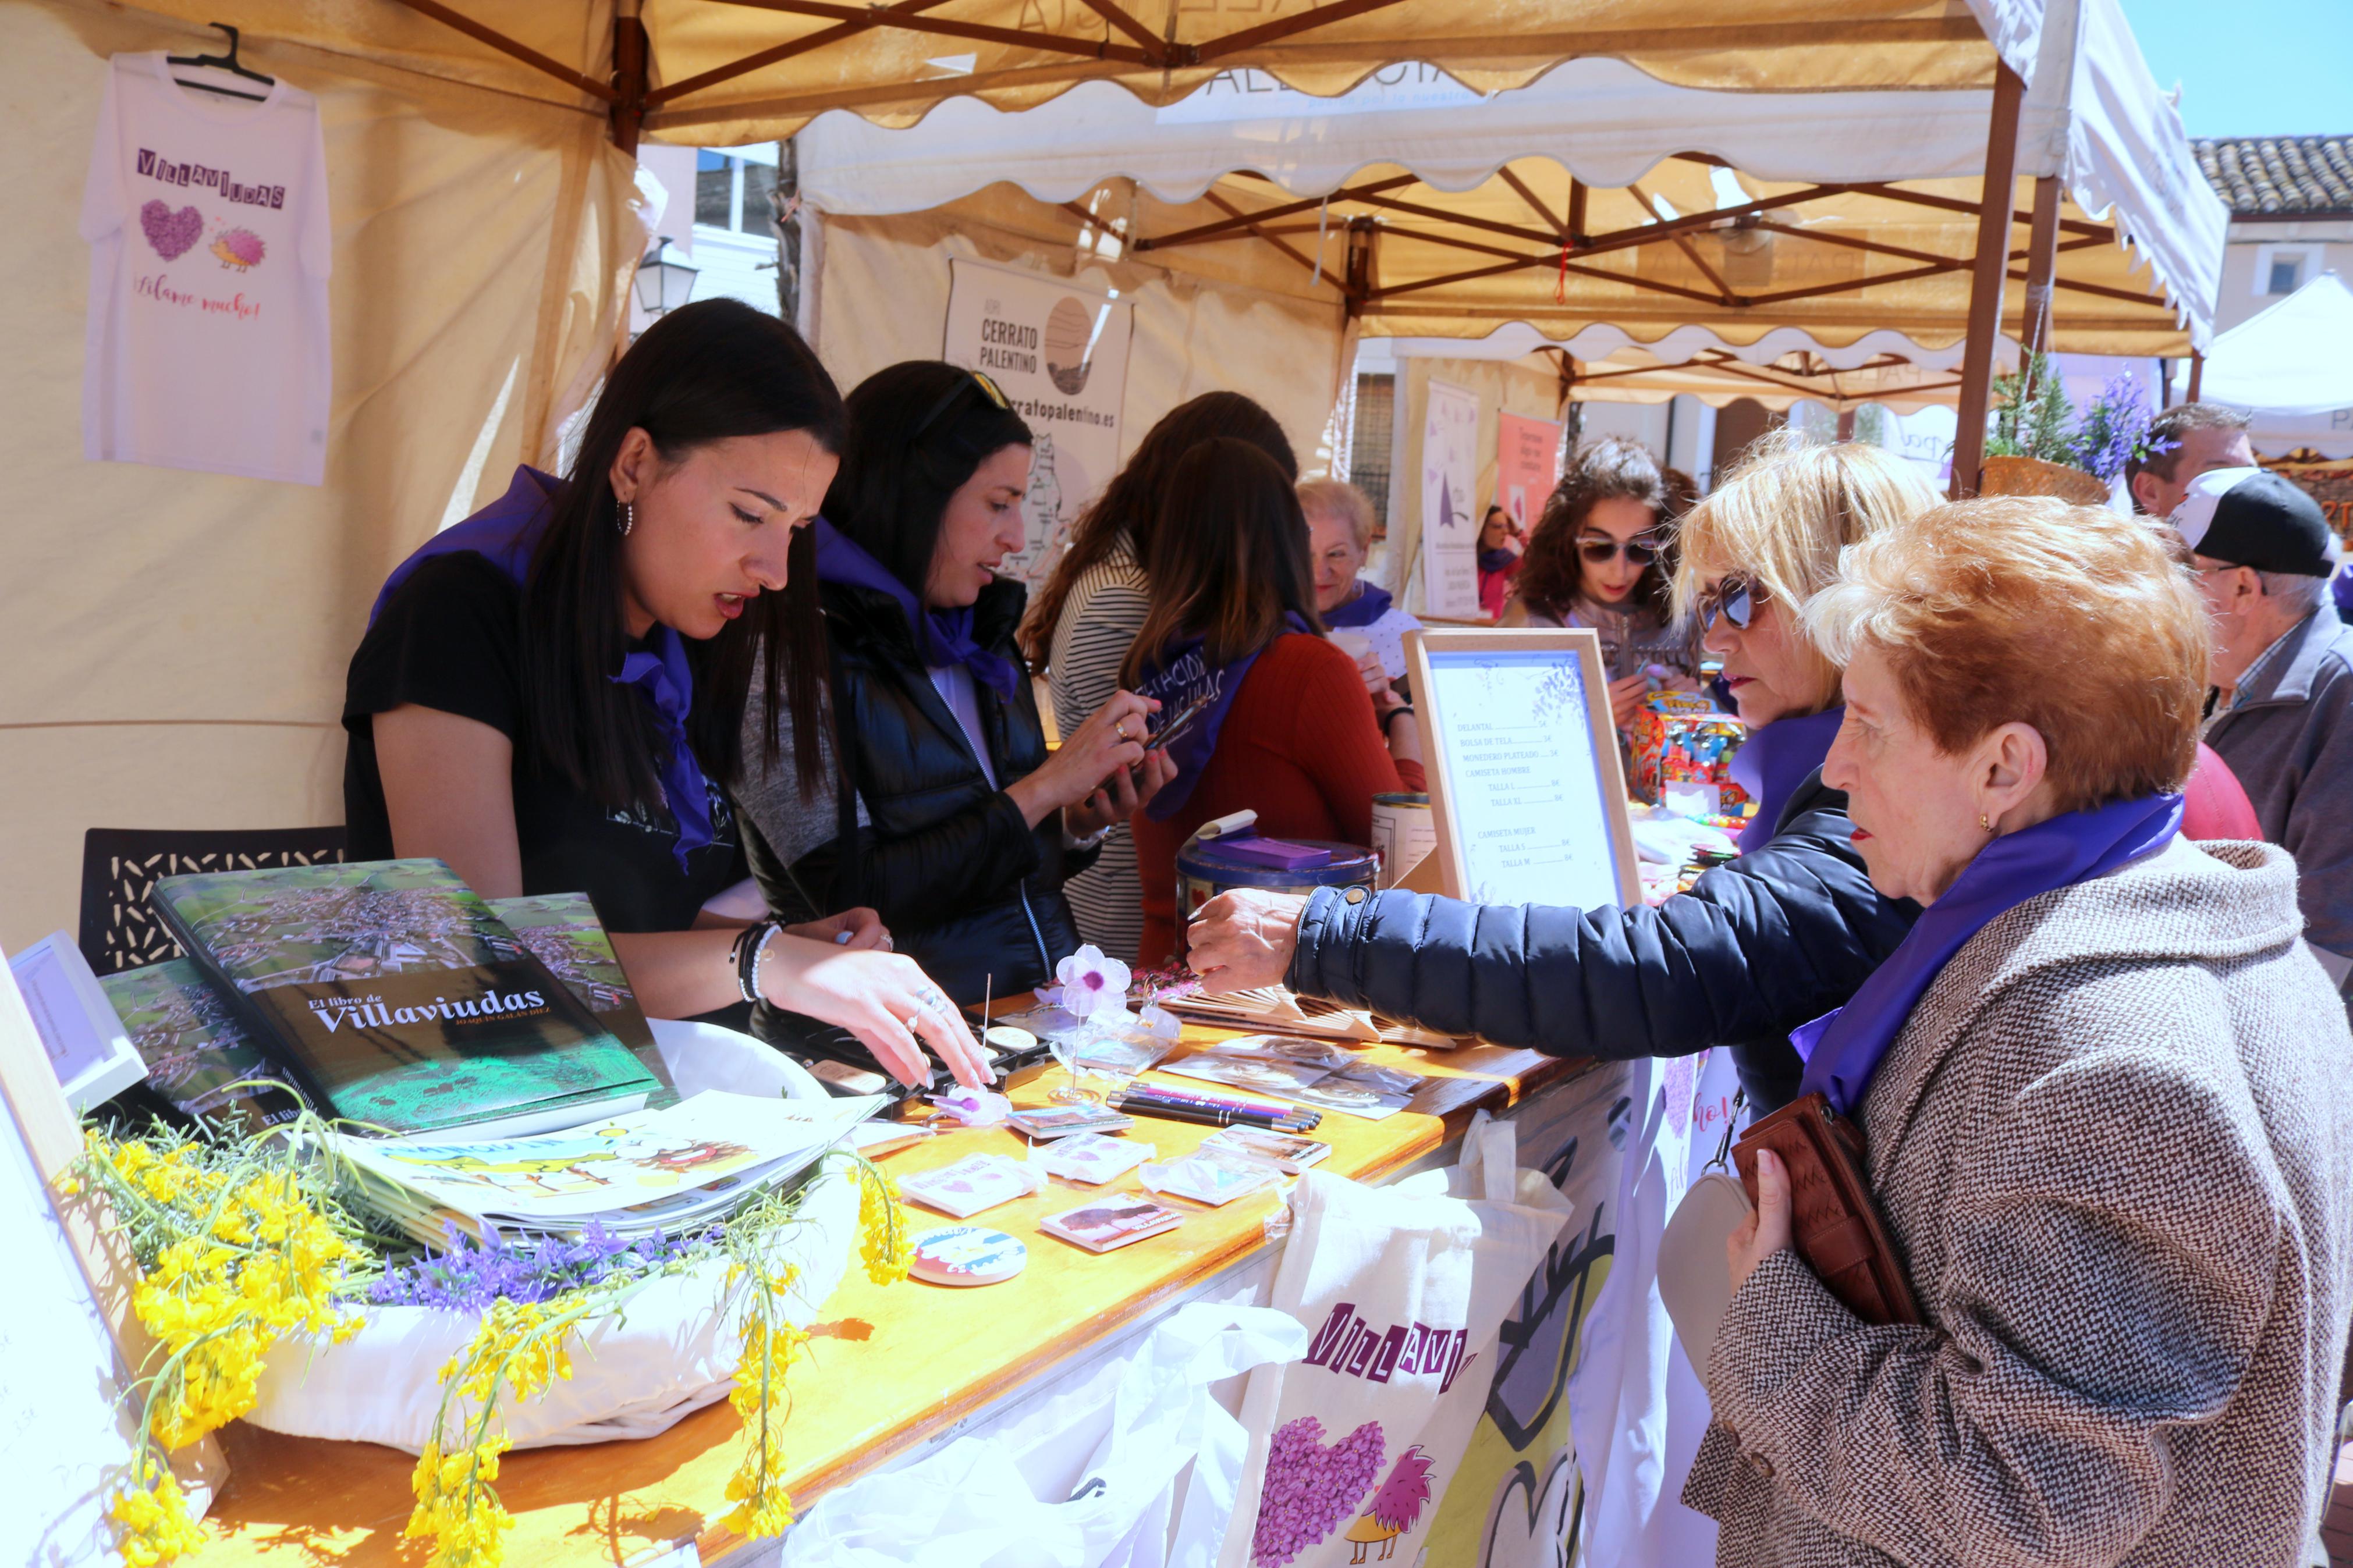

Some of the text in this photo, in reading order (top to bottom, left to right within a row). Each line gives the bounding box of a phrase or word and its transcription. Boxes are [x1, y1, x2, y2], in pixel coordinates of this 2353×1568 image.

[137, 148, 285, 209] VILLAVIUDAS
[981, 318, 1038, 351] CERRATO
[979, 346, 1037, 374] PALENTINO
[1457, 723, 1494, 733] DELANTAL
[1460, 738, 1484, 748] BOLSA
[1484, 738, 1494, 746] DE
[1495, 737, 1513, 745] TELA
[1463, 752, 1503, 762] MONEDERO
[1503, 750, 1539, 760] PLATEADO
[1465, 766, 1532, 778] CAMISETA HOMBRE
[1488, 783, 1510, 792] TALLA
[1490, 798, 1513, 807] TALLA
[1513, 797, 1522, 805] XL
[1477, 826, 1536, 839] CAMISETA MUJER
[1499, 844, 1520, 853] TALLA
[1501, 859, 1523, 868] TALLA
[308, 994, 383, 1010] El libro de
[313, 989, 545, 1034] Villaviudas
[496, 1010, 528, 1022] GALÁN
[261, 1107, 304, 1126] El libr
[1301, 1303, 1478, 1395] VILLAVI
